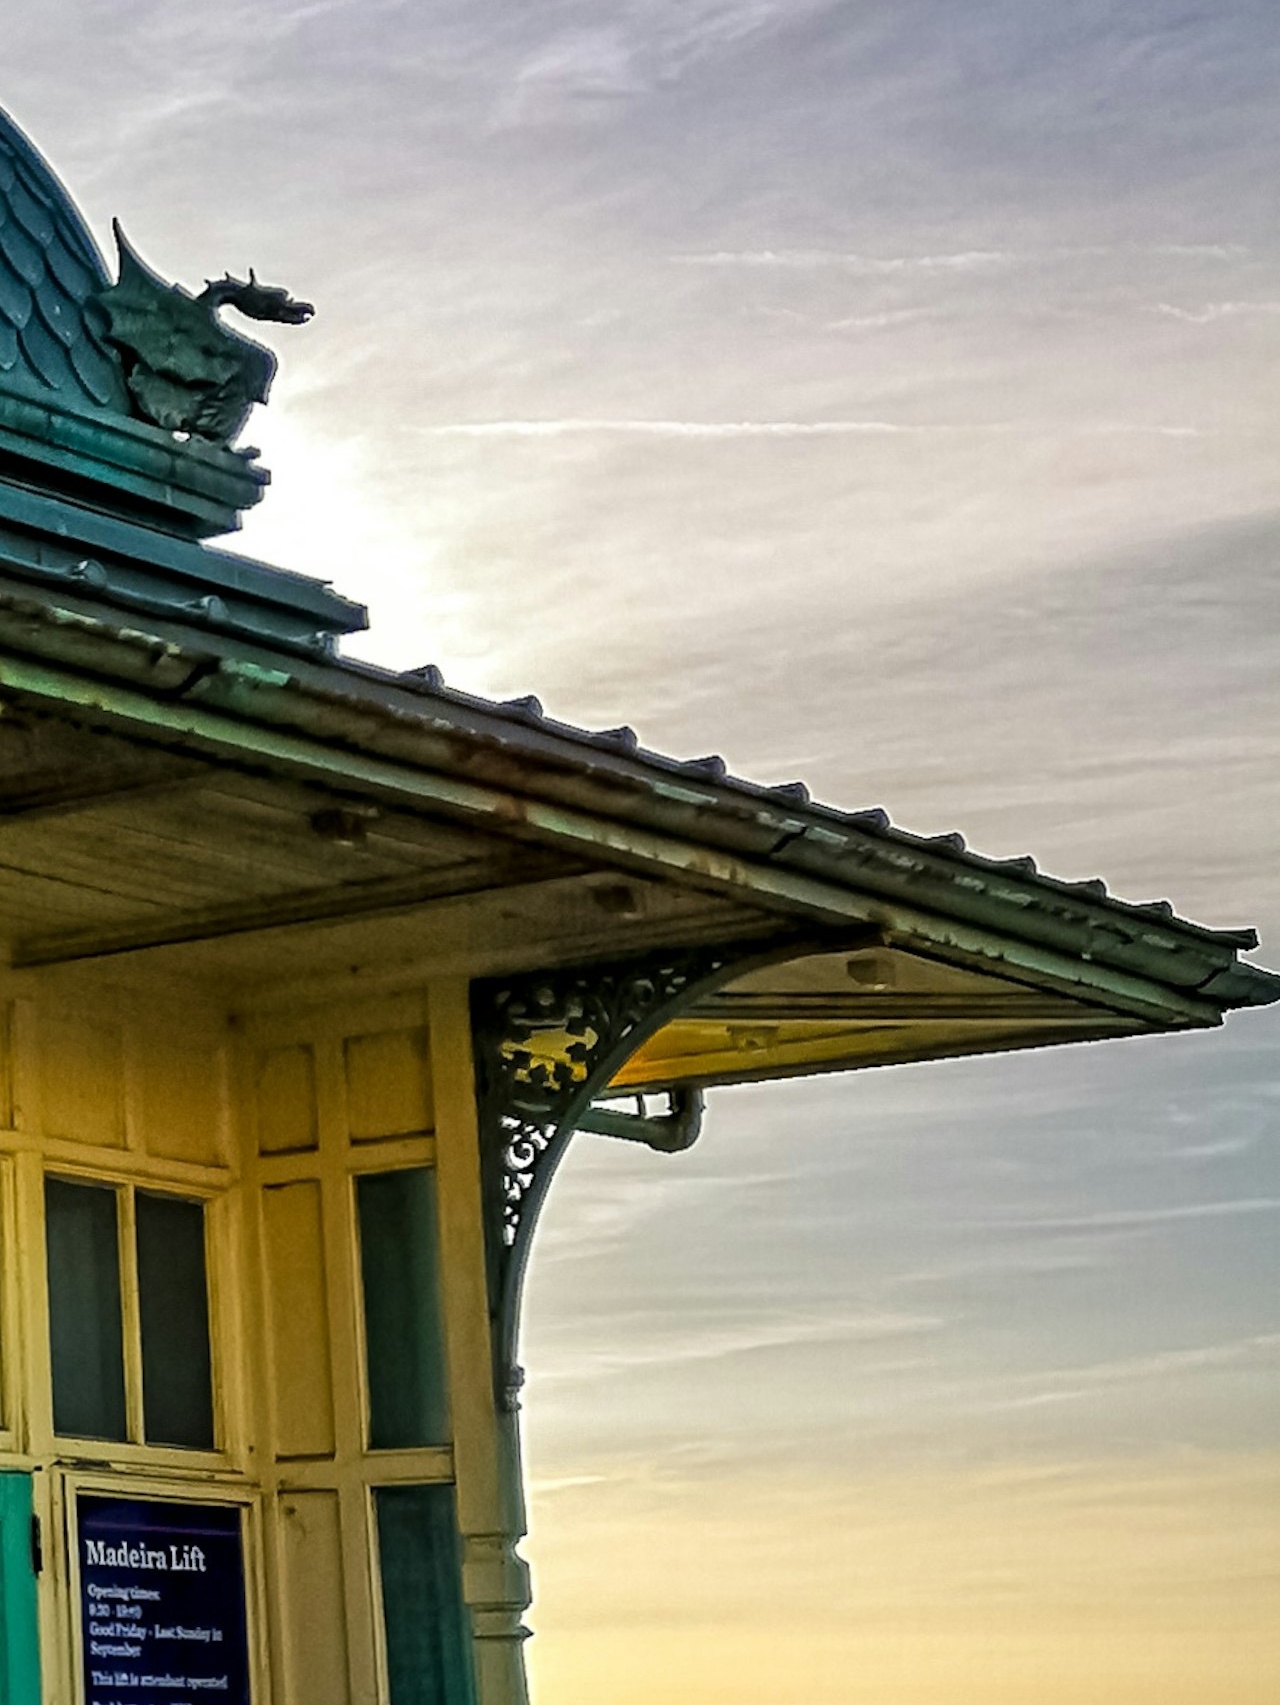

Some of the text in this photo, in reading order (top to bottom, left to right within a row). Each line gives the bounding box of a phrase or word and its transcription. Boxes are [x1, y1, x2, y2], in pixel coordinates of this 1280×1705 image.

[85, 1540, 207, 1572] Madeira Lift
[90, 1621, 114, 1636] Good
[115, 1623, 147, 1640] Friday
[155, 1624, 176, 1639] Last
[176, 1625, 211, 1643] Sunday
[90, 1640, 142, 1658] September
[92, 1671, 113, 1686] This
